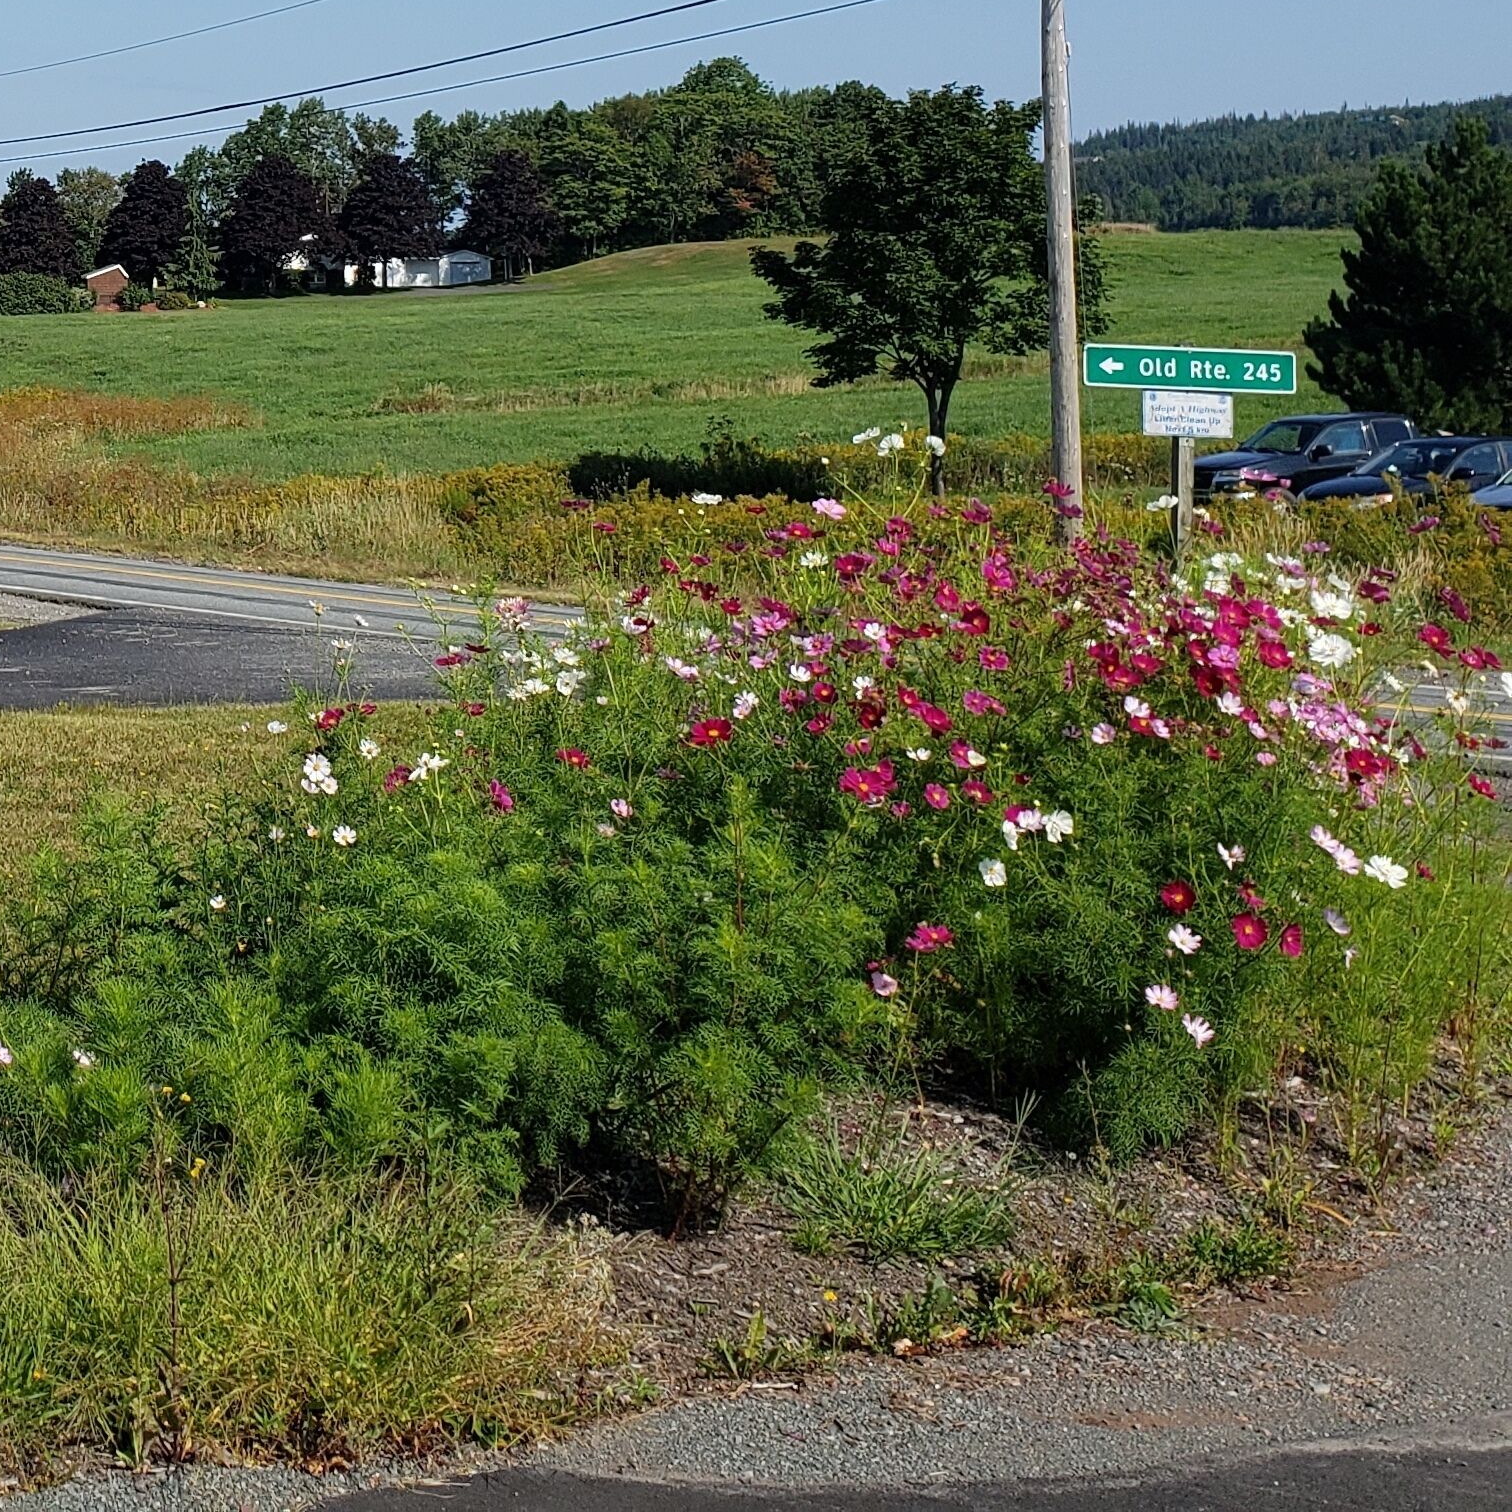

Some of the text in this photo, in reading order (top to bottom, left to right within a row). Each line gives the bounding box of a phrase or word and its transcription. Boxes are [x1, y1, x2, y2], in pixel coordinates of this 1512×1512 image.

[1139, 357, 1282, 382] Old Rte. 245
